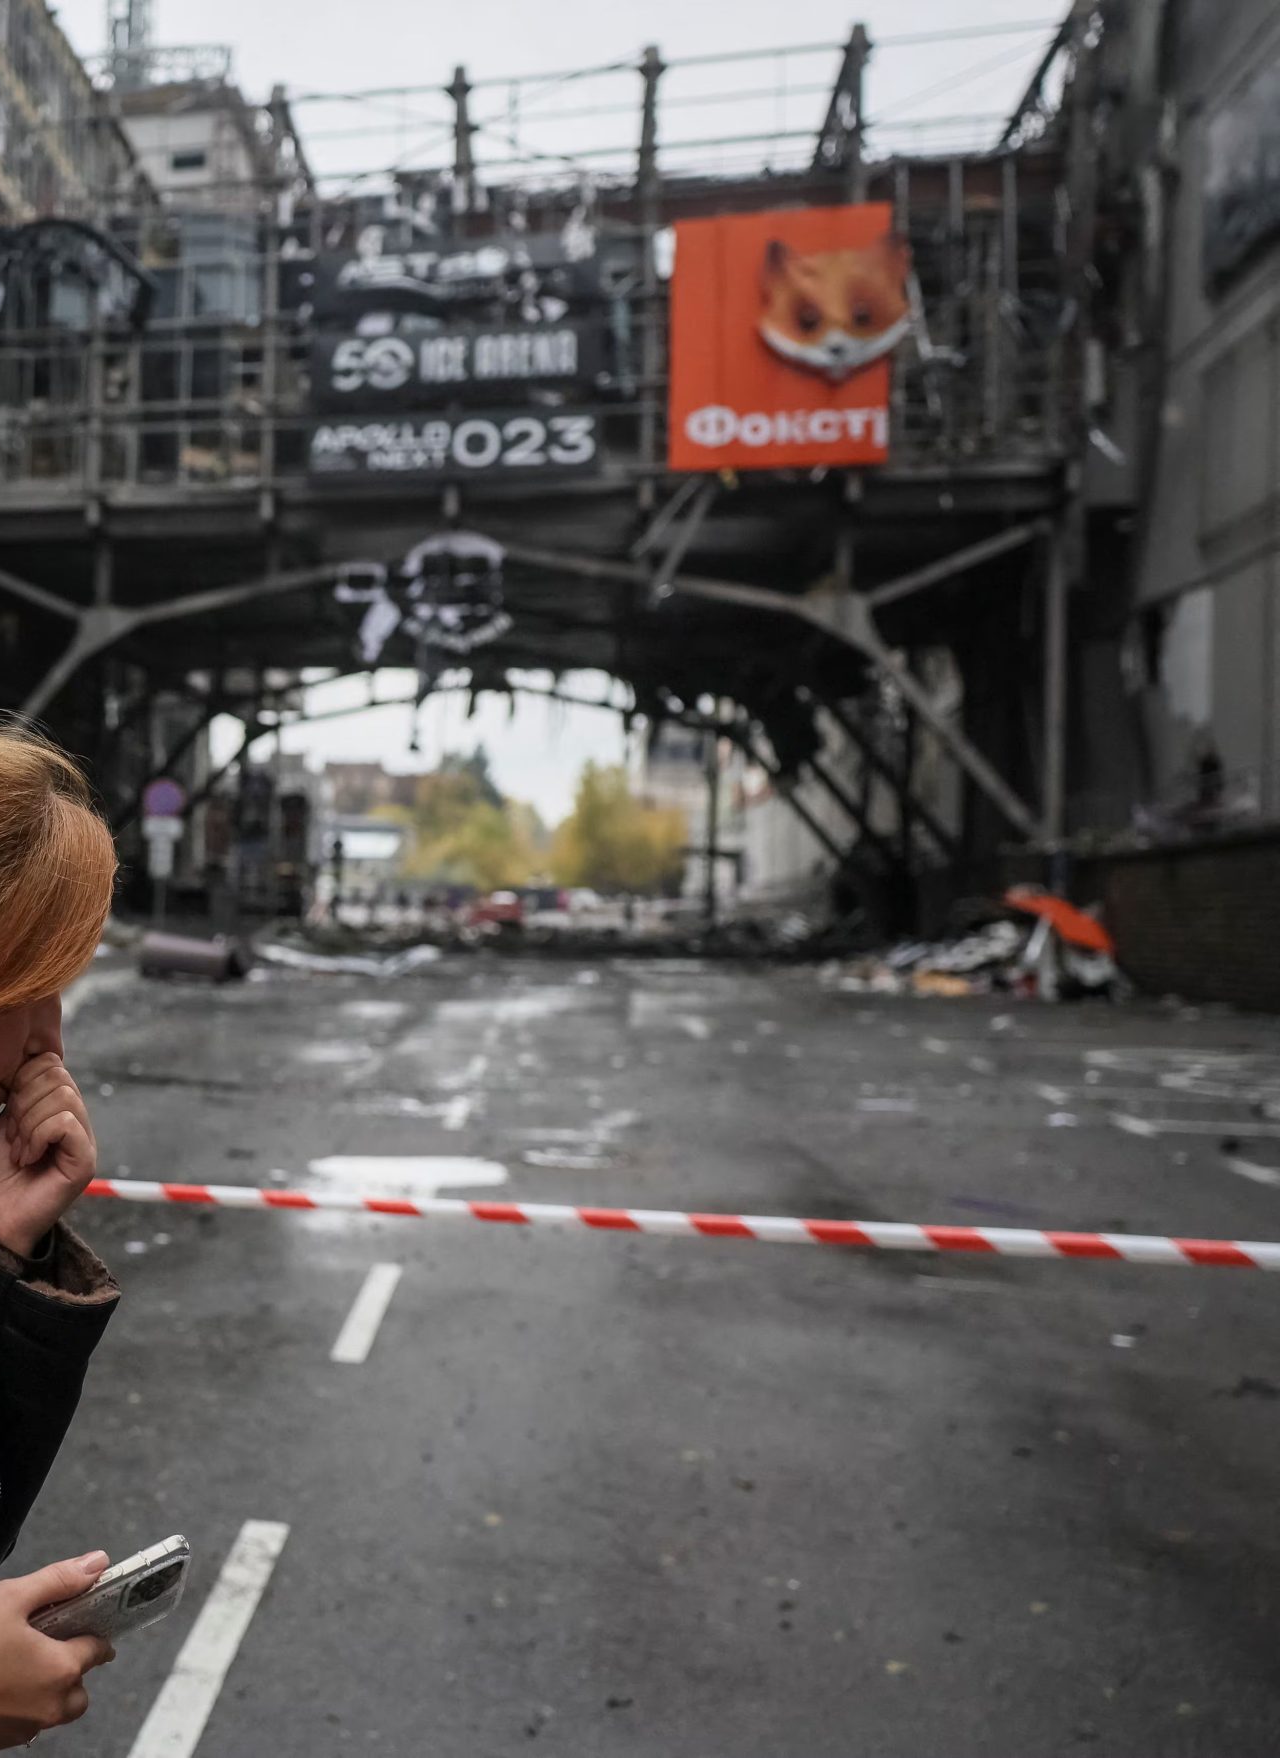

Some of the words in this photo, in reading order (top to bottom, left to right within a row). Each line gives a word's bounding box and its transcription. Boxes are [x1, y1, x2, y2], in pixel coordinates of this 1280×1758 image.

[420, 335, 467, 383] ICE
[474, 330, 578, 379] ARENA
[311, 420, 451, 453] APOLLO
[452, 416, 596, 467] 023
[367, 449, 446, 471] NEXT
